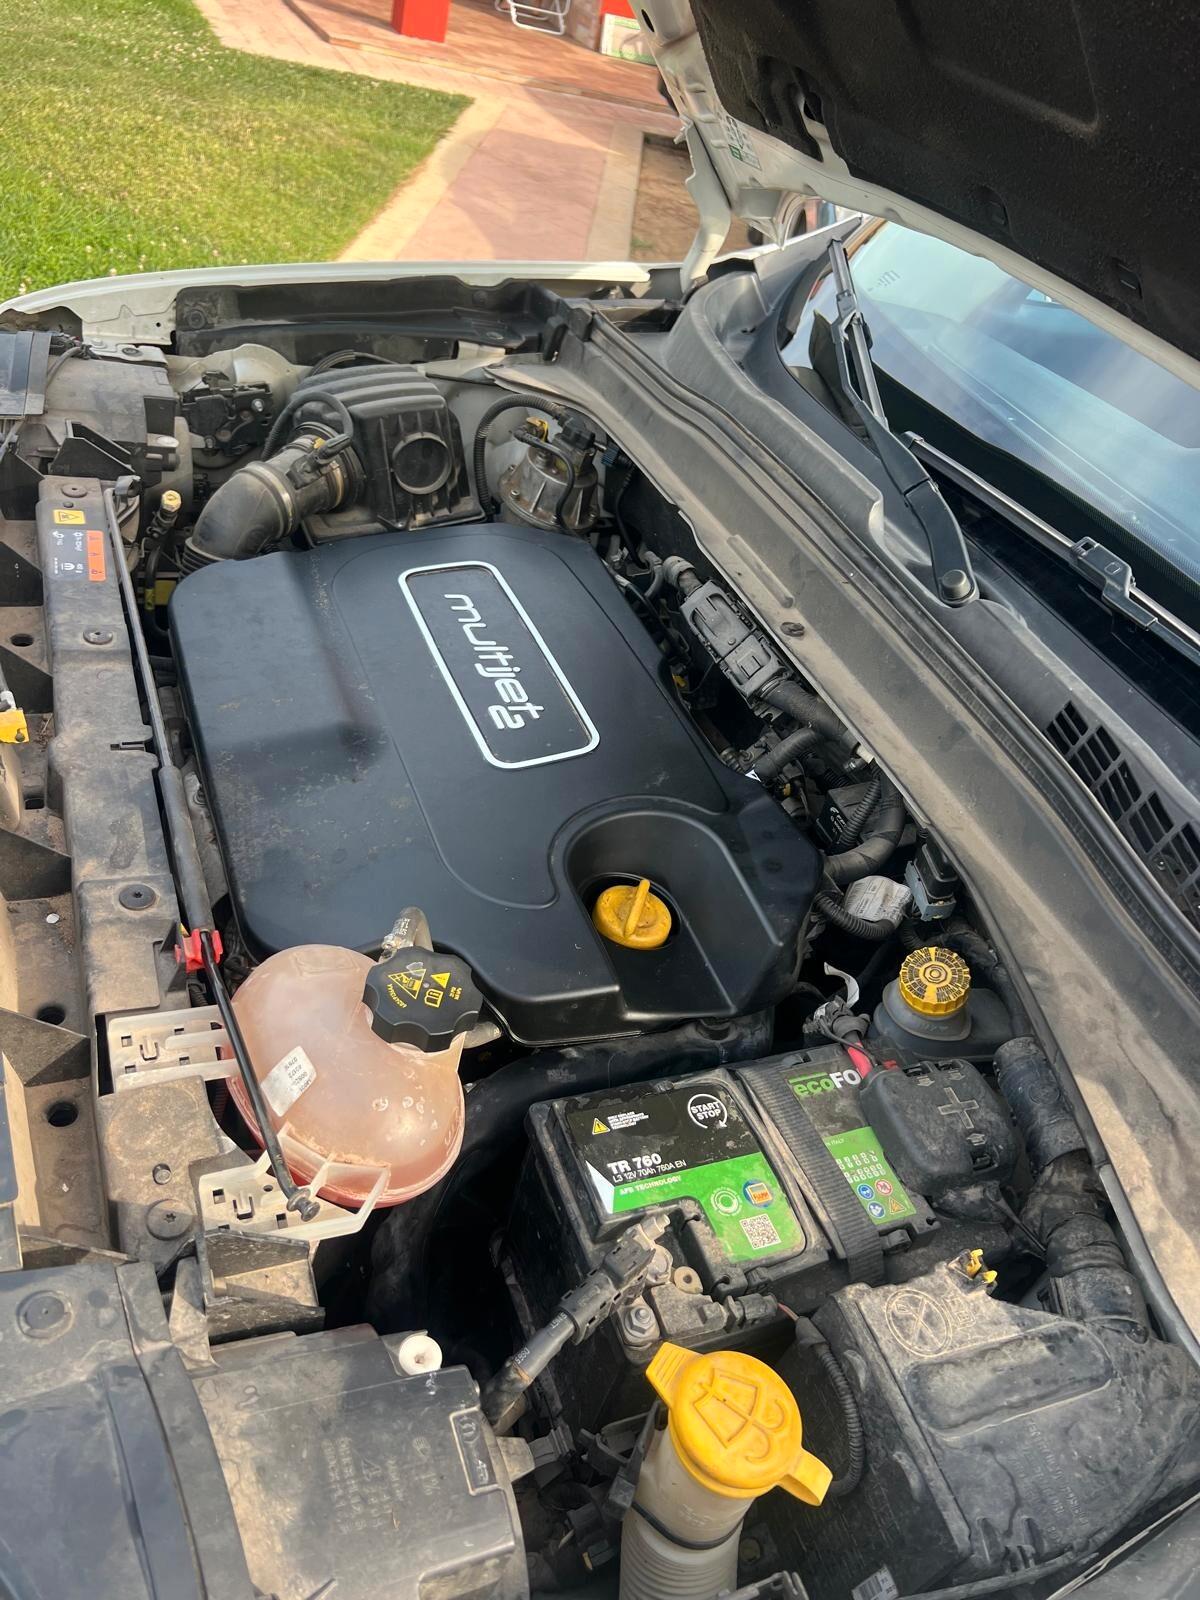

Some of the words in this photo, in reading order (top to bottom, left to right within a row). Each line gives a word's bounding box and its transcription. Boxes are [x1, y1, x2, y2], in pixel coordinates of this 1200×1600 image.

[444, 593, 544, 719] multijet
[690, 1101, 721, 1114] START
[696, 1109, 721, 1120] STOP
[606, 1160, 631, 1175] TR
[632, 1153, 662, 1169] 760
[612, 1174, 624, 1183] L3
[623, 1170, 637, 1180] 12V
[637, 1167, 657, 1177] 70Ah
[674, 1159, 688, 1169] EN
